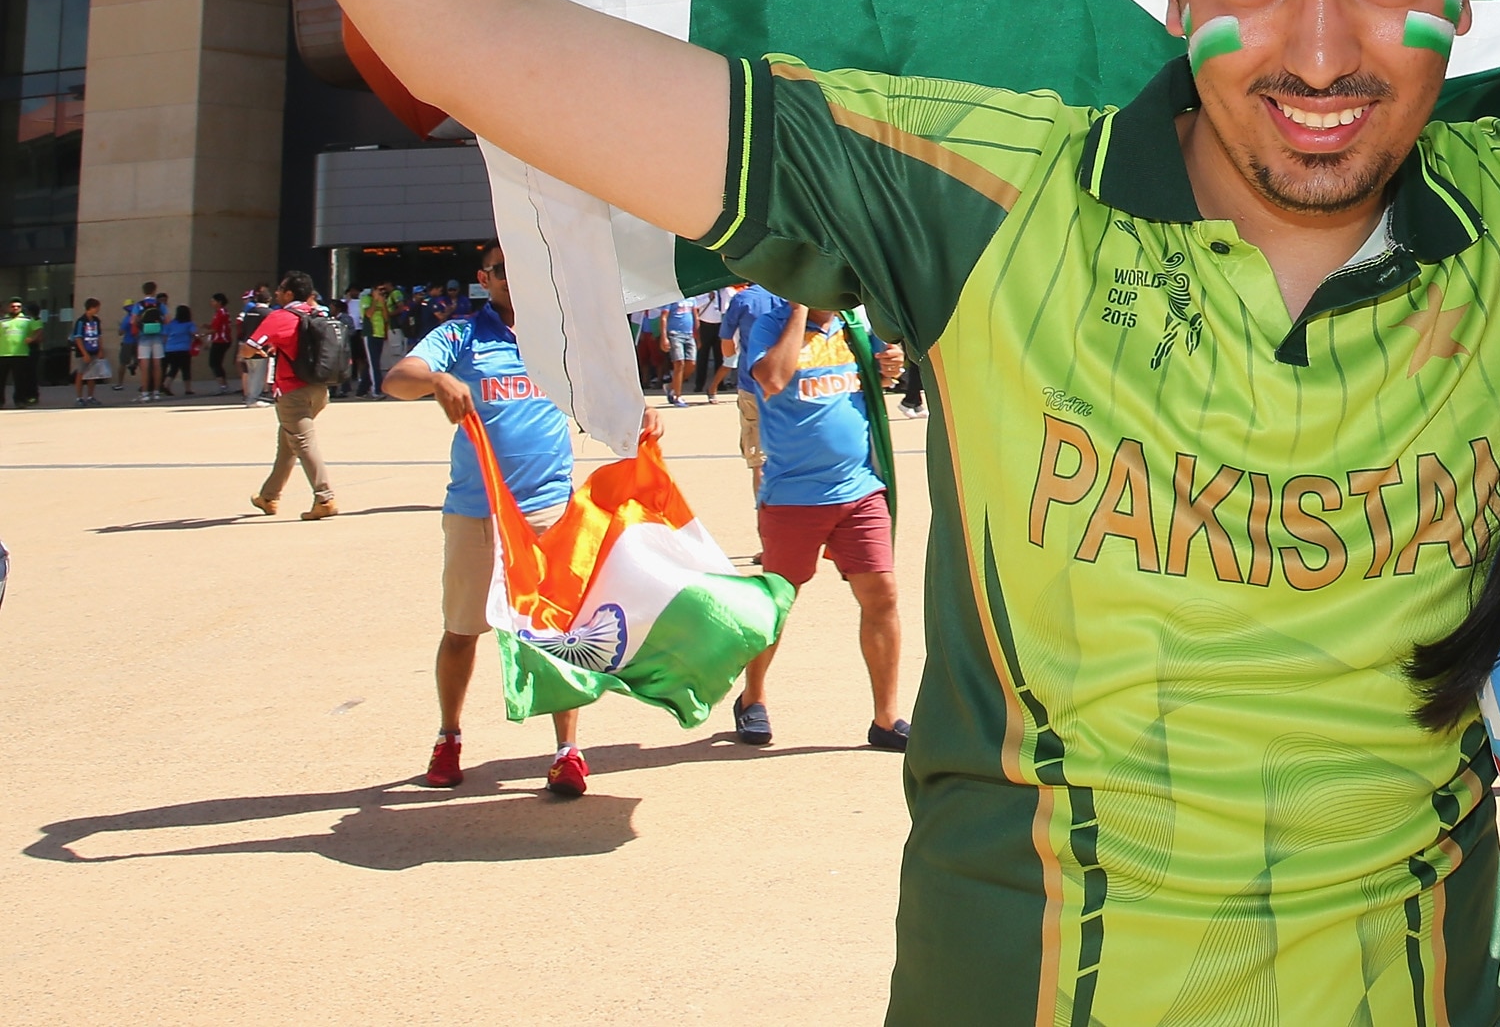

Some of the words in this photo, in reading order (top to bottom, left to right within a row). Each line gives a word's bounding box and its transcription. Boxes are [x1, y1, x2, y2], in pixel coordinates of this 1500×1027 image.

[1114, 268, 1162, 289] WORLD
[1107, 288, 1138, 306] CUP
[1101, 307, 1138, 328] 2015
[481, 375, 547, 402] INDI
[1042, 386, 1094, 417] TEAM
